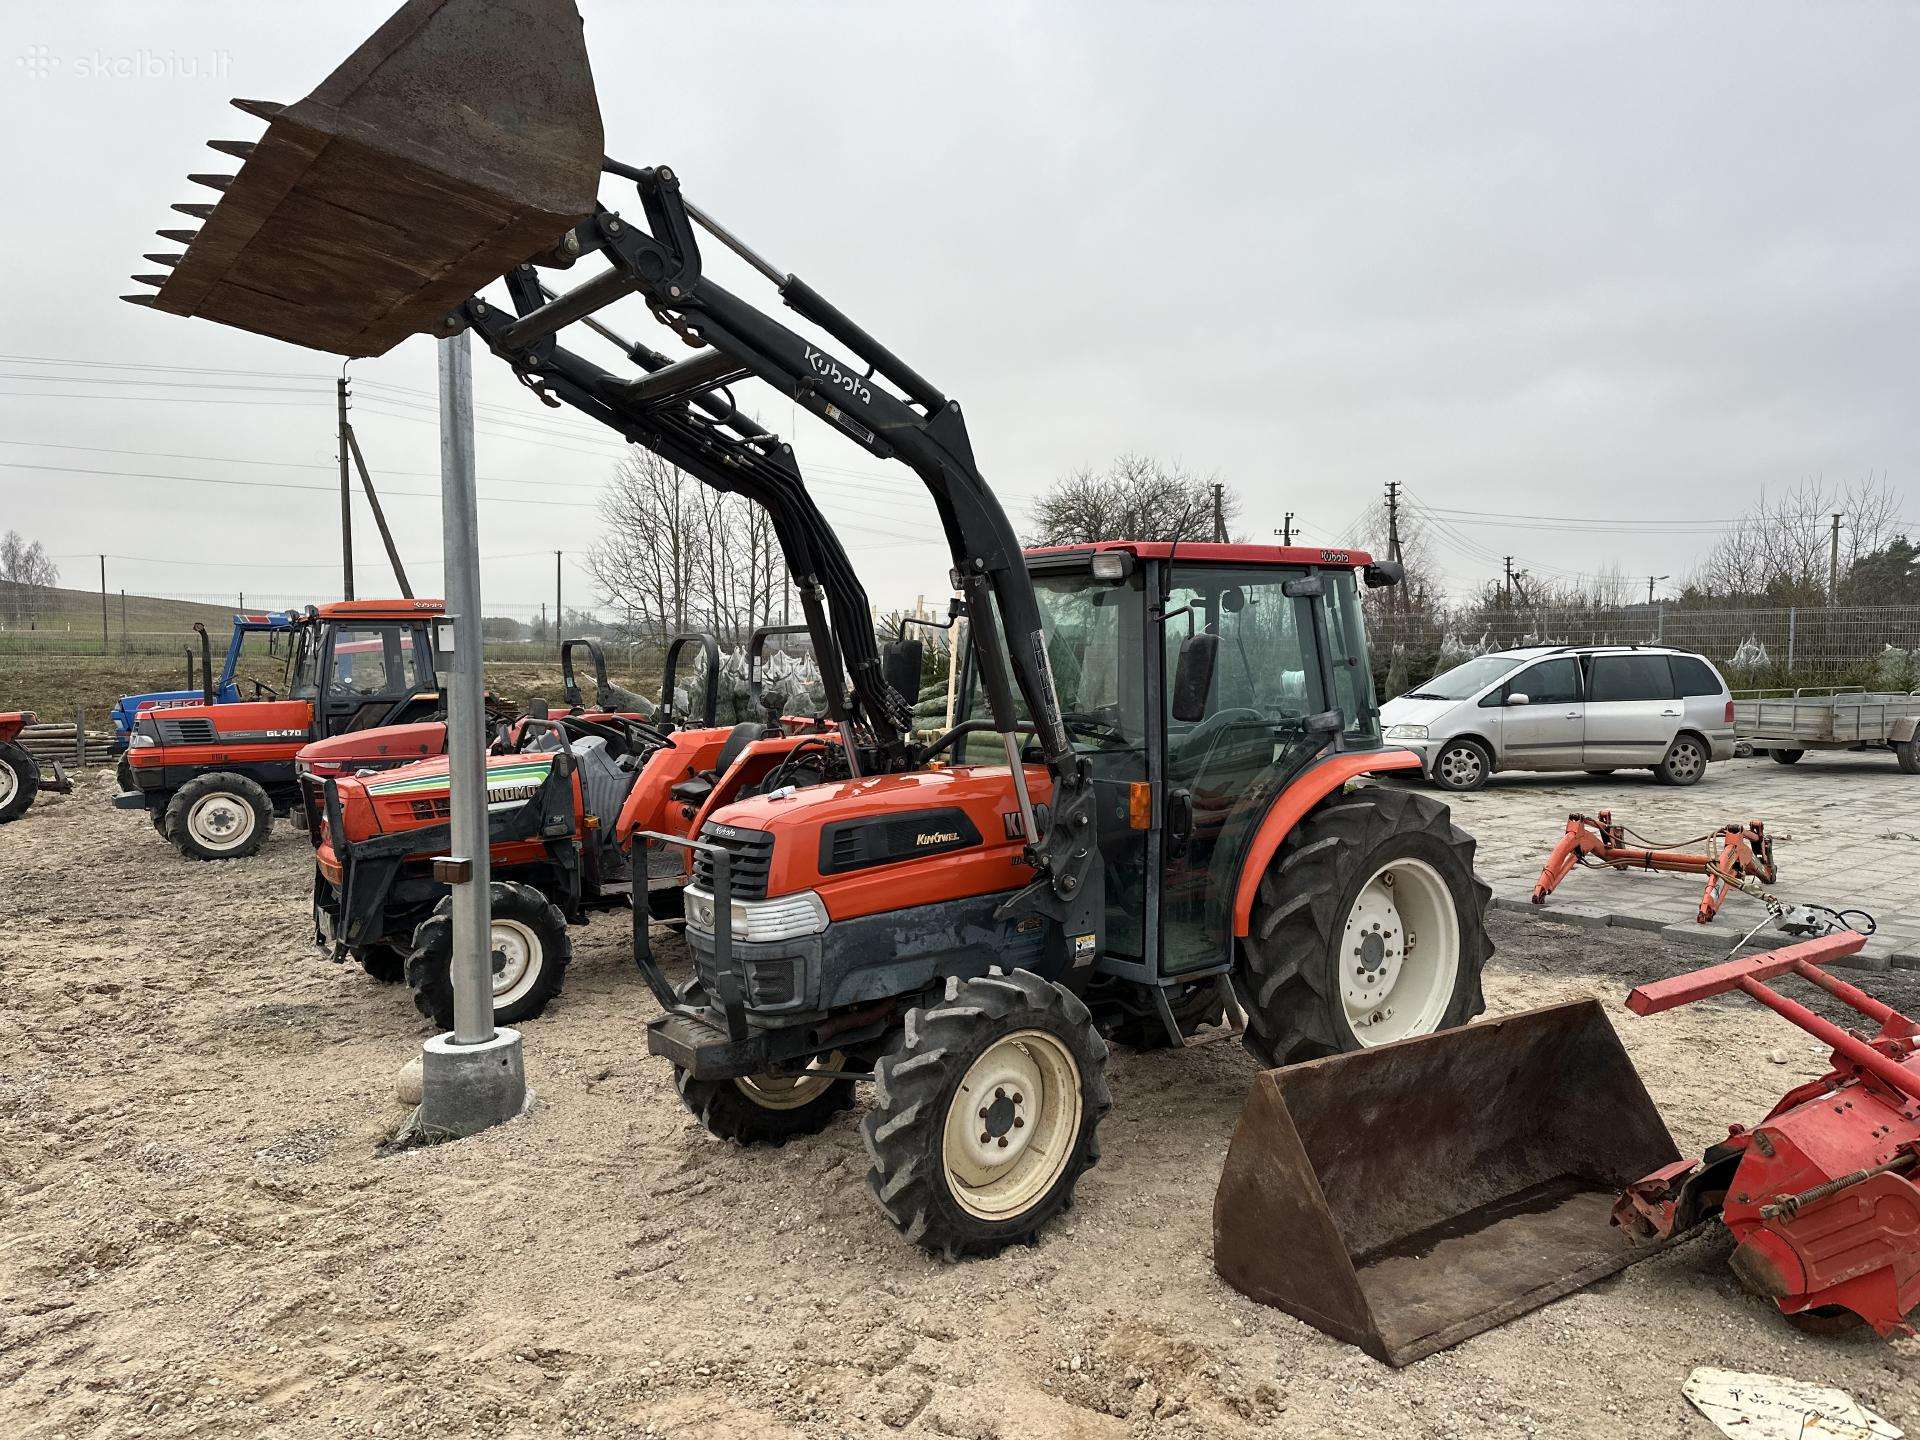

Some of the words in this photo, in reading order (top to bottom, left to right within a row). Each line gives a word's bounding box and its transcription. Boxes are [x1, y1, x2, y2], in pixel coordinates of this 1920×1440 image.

[804, 345, 871, 405] Kubota
[1321, 550, 1349, 563] Kubota
[266, 729, 302, 737] GL470
